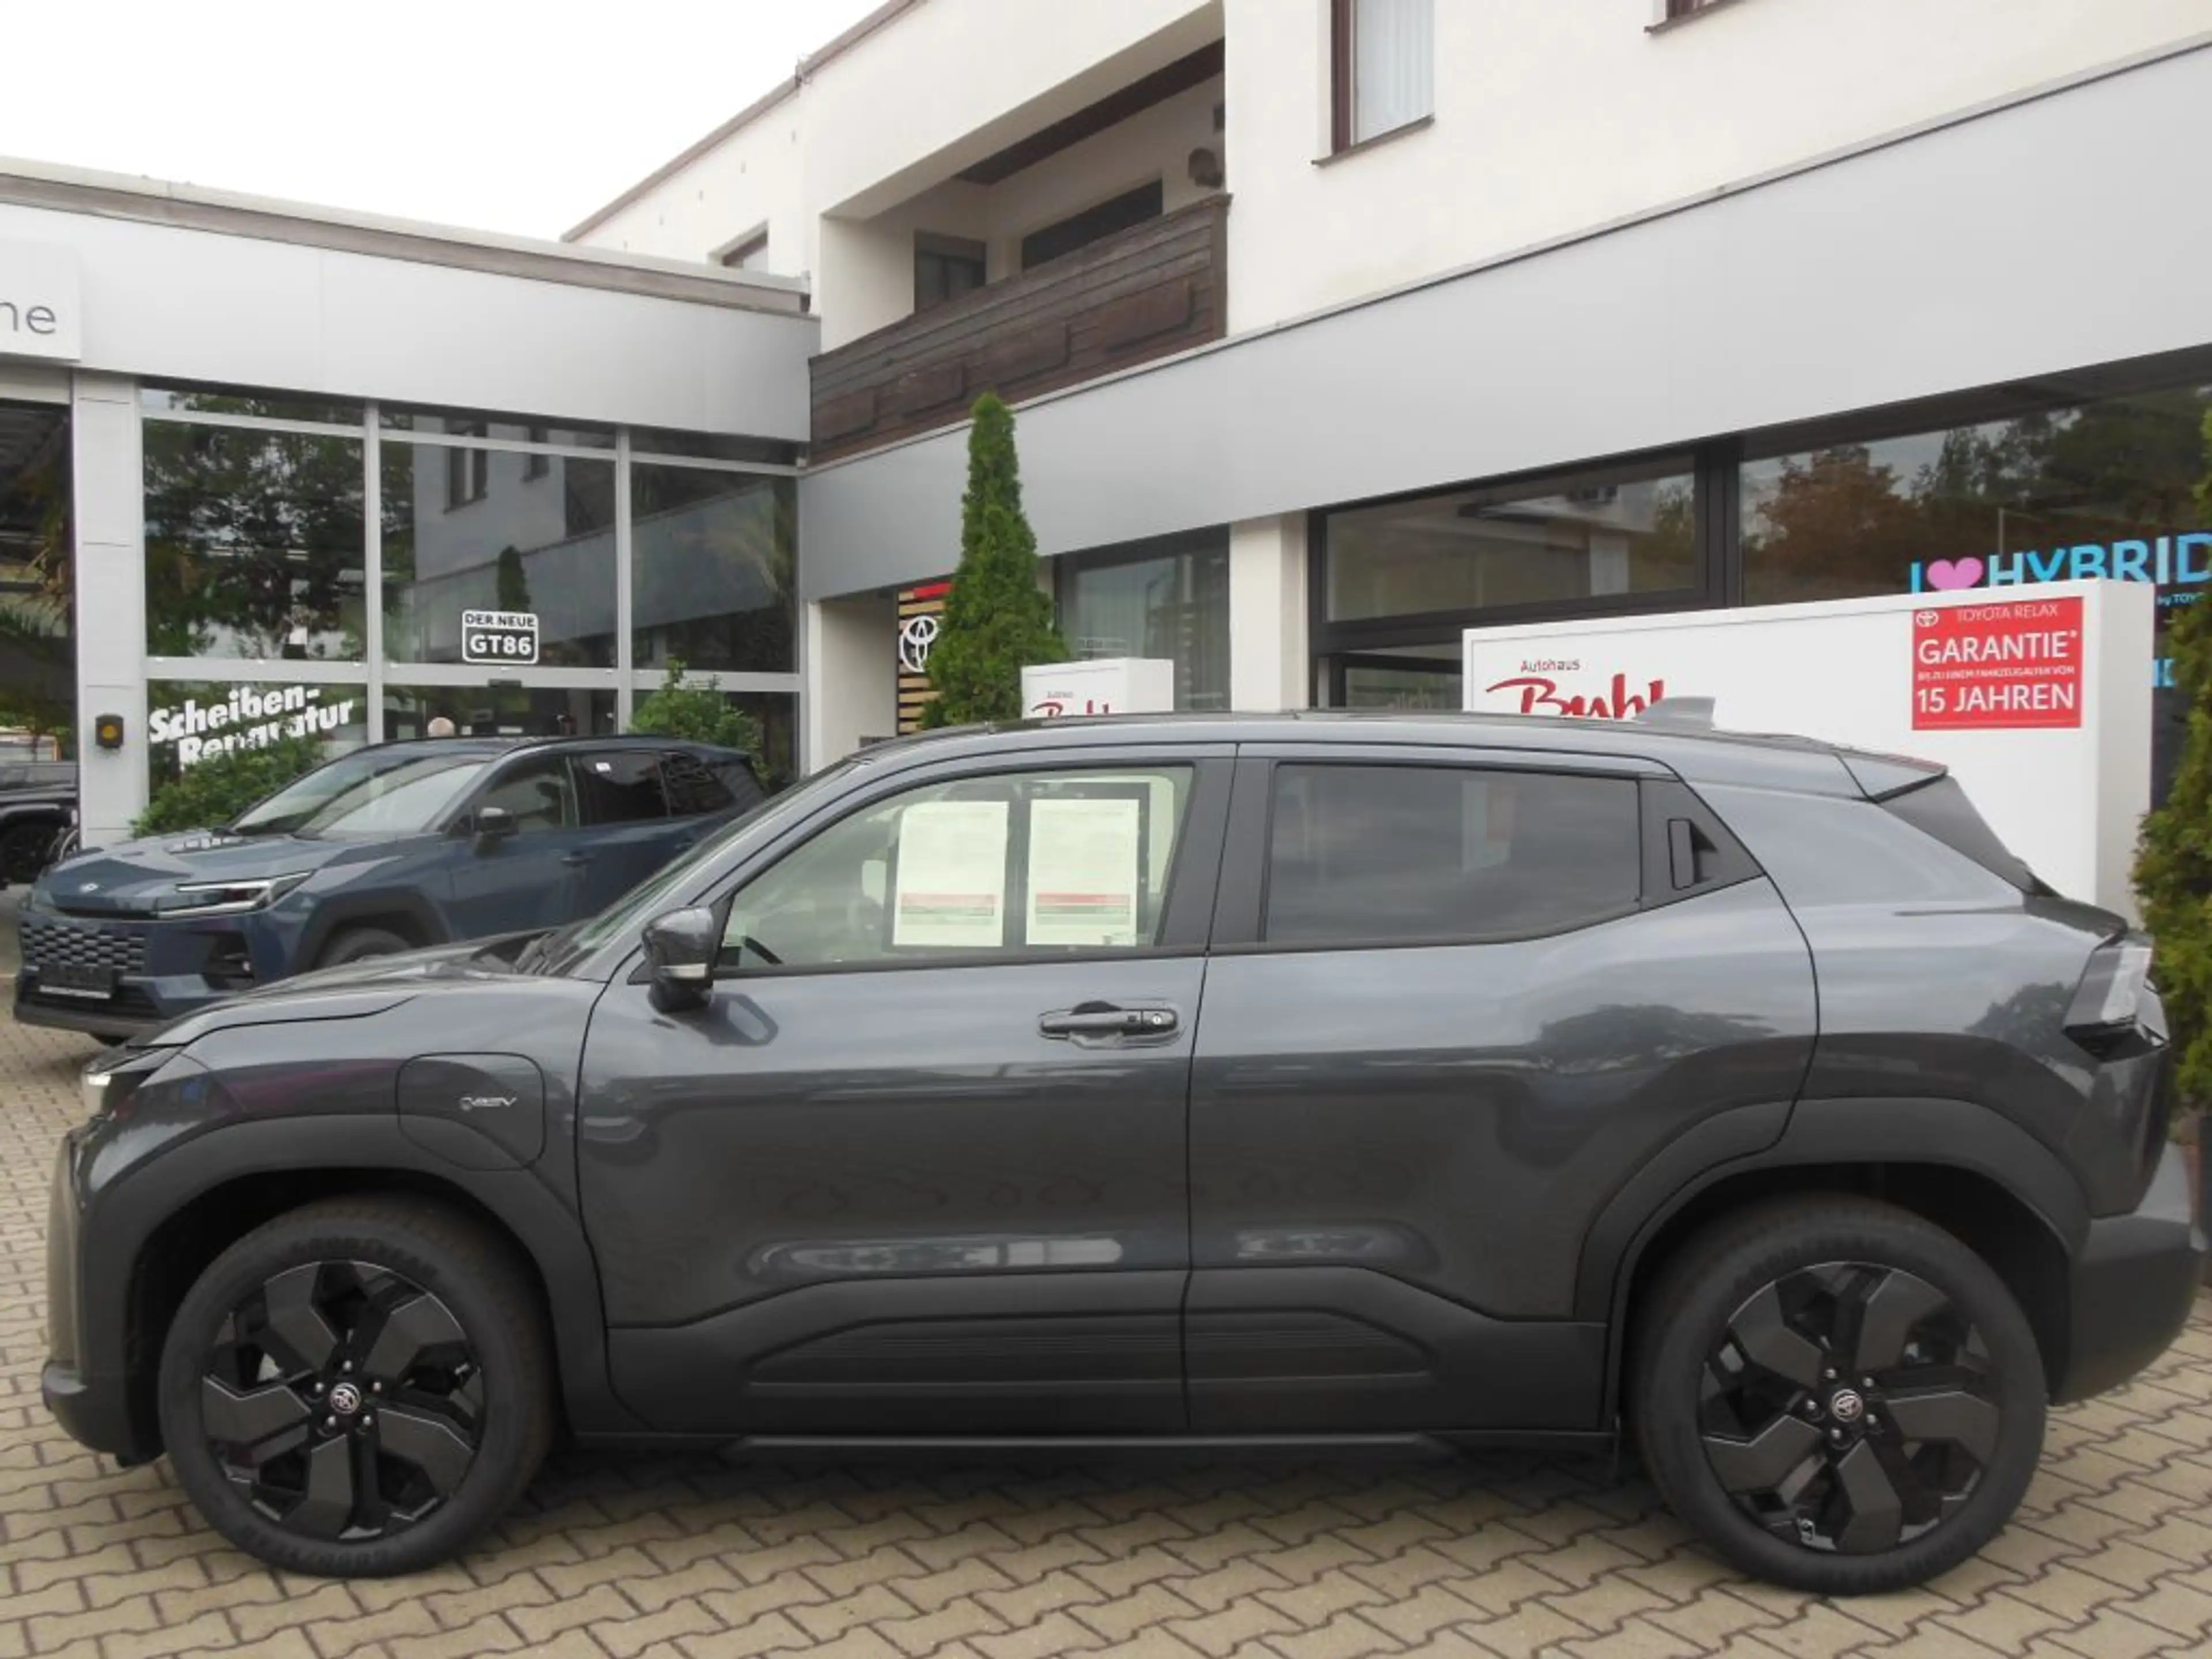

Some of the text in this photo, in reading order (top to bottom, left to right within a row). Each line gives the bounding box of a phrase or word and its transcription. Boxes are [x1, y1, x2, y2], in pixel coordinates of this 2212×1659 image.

[1911, 532, 2212, 593] I HYBRID
[465, 613, 535, 627] DER NEUE
[1957, 604, 2059, 622] TOYOTA RELAX
[470, 634, 532, 656] GT86
[1521, 660, 1581, 672] Autohaus
[1918, 683, 2074, 713] 15 JAHREN
[149, 685, 320, 743] Scheiben-
